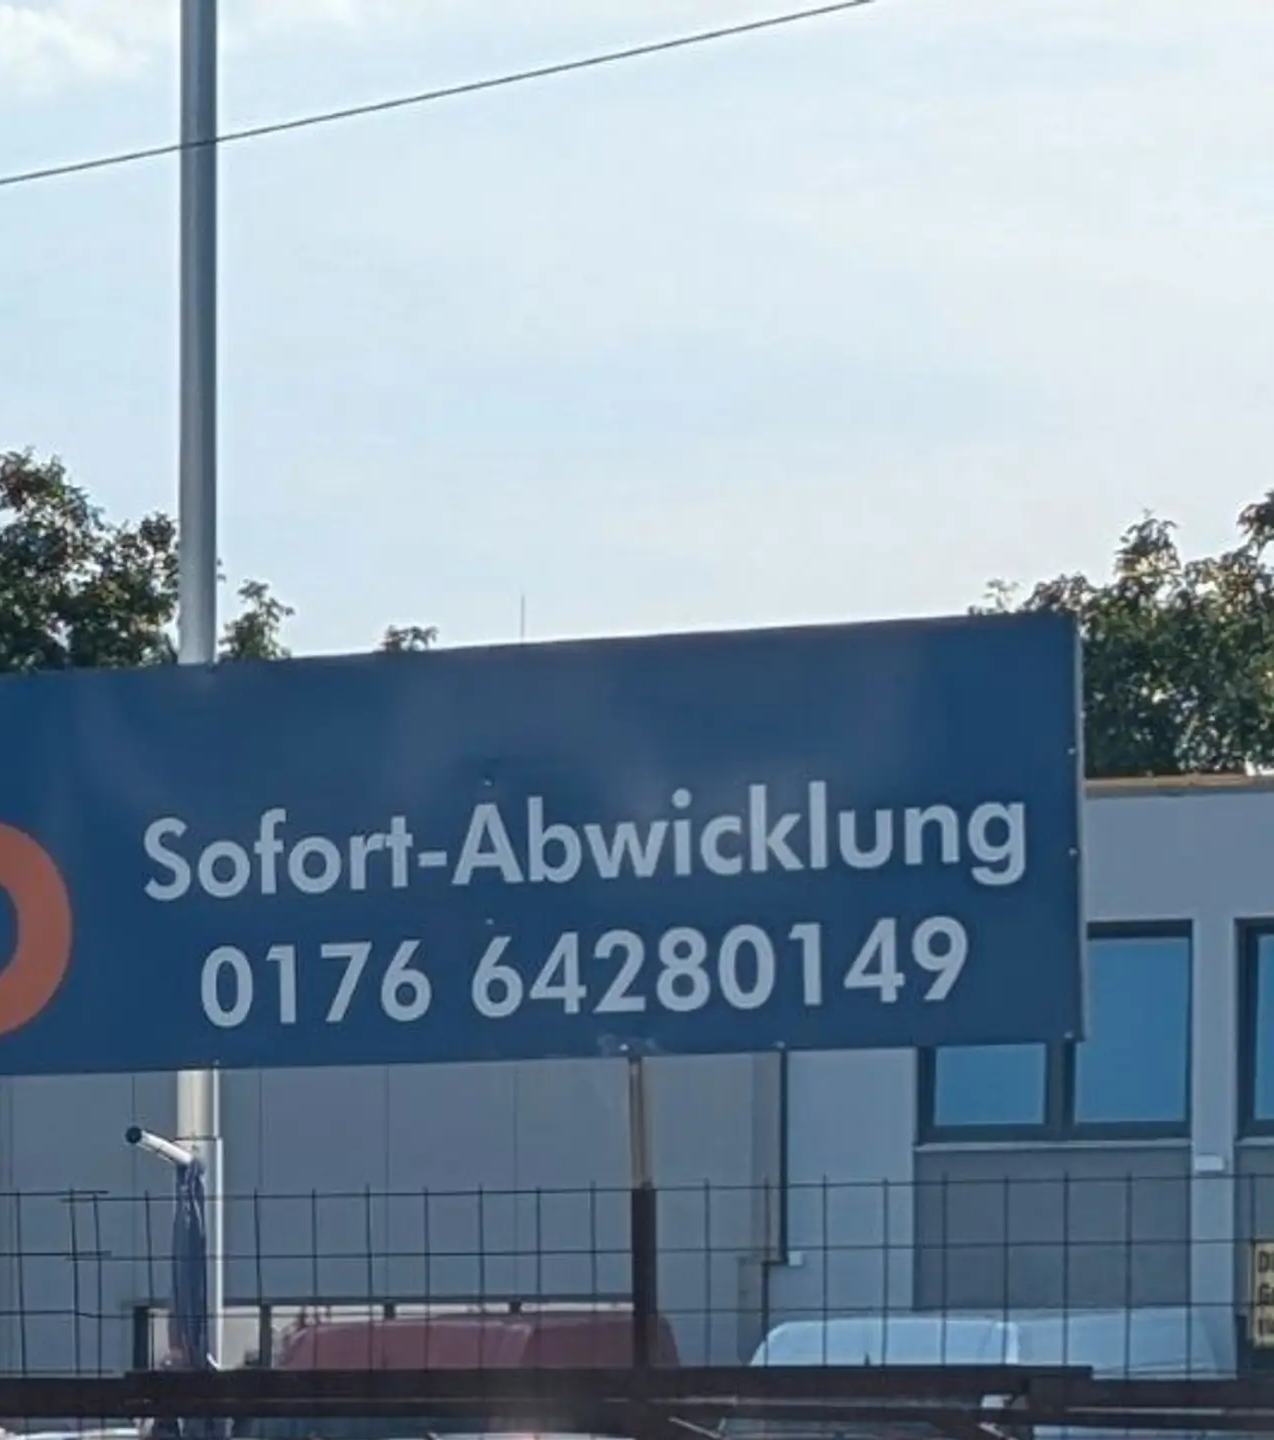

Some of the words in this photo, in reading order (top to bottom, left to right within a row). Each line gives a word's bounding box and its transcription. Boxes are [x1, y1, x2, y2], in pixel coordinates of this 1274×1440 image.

[143, 781, 1026, 901] Sofort-Abwicklung
[200, 940, 432, 1028] 0176
[471, 915, 968, 1018] 64280149
